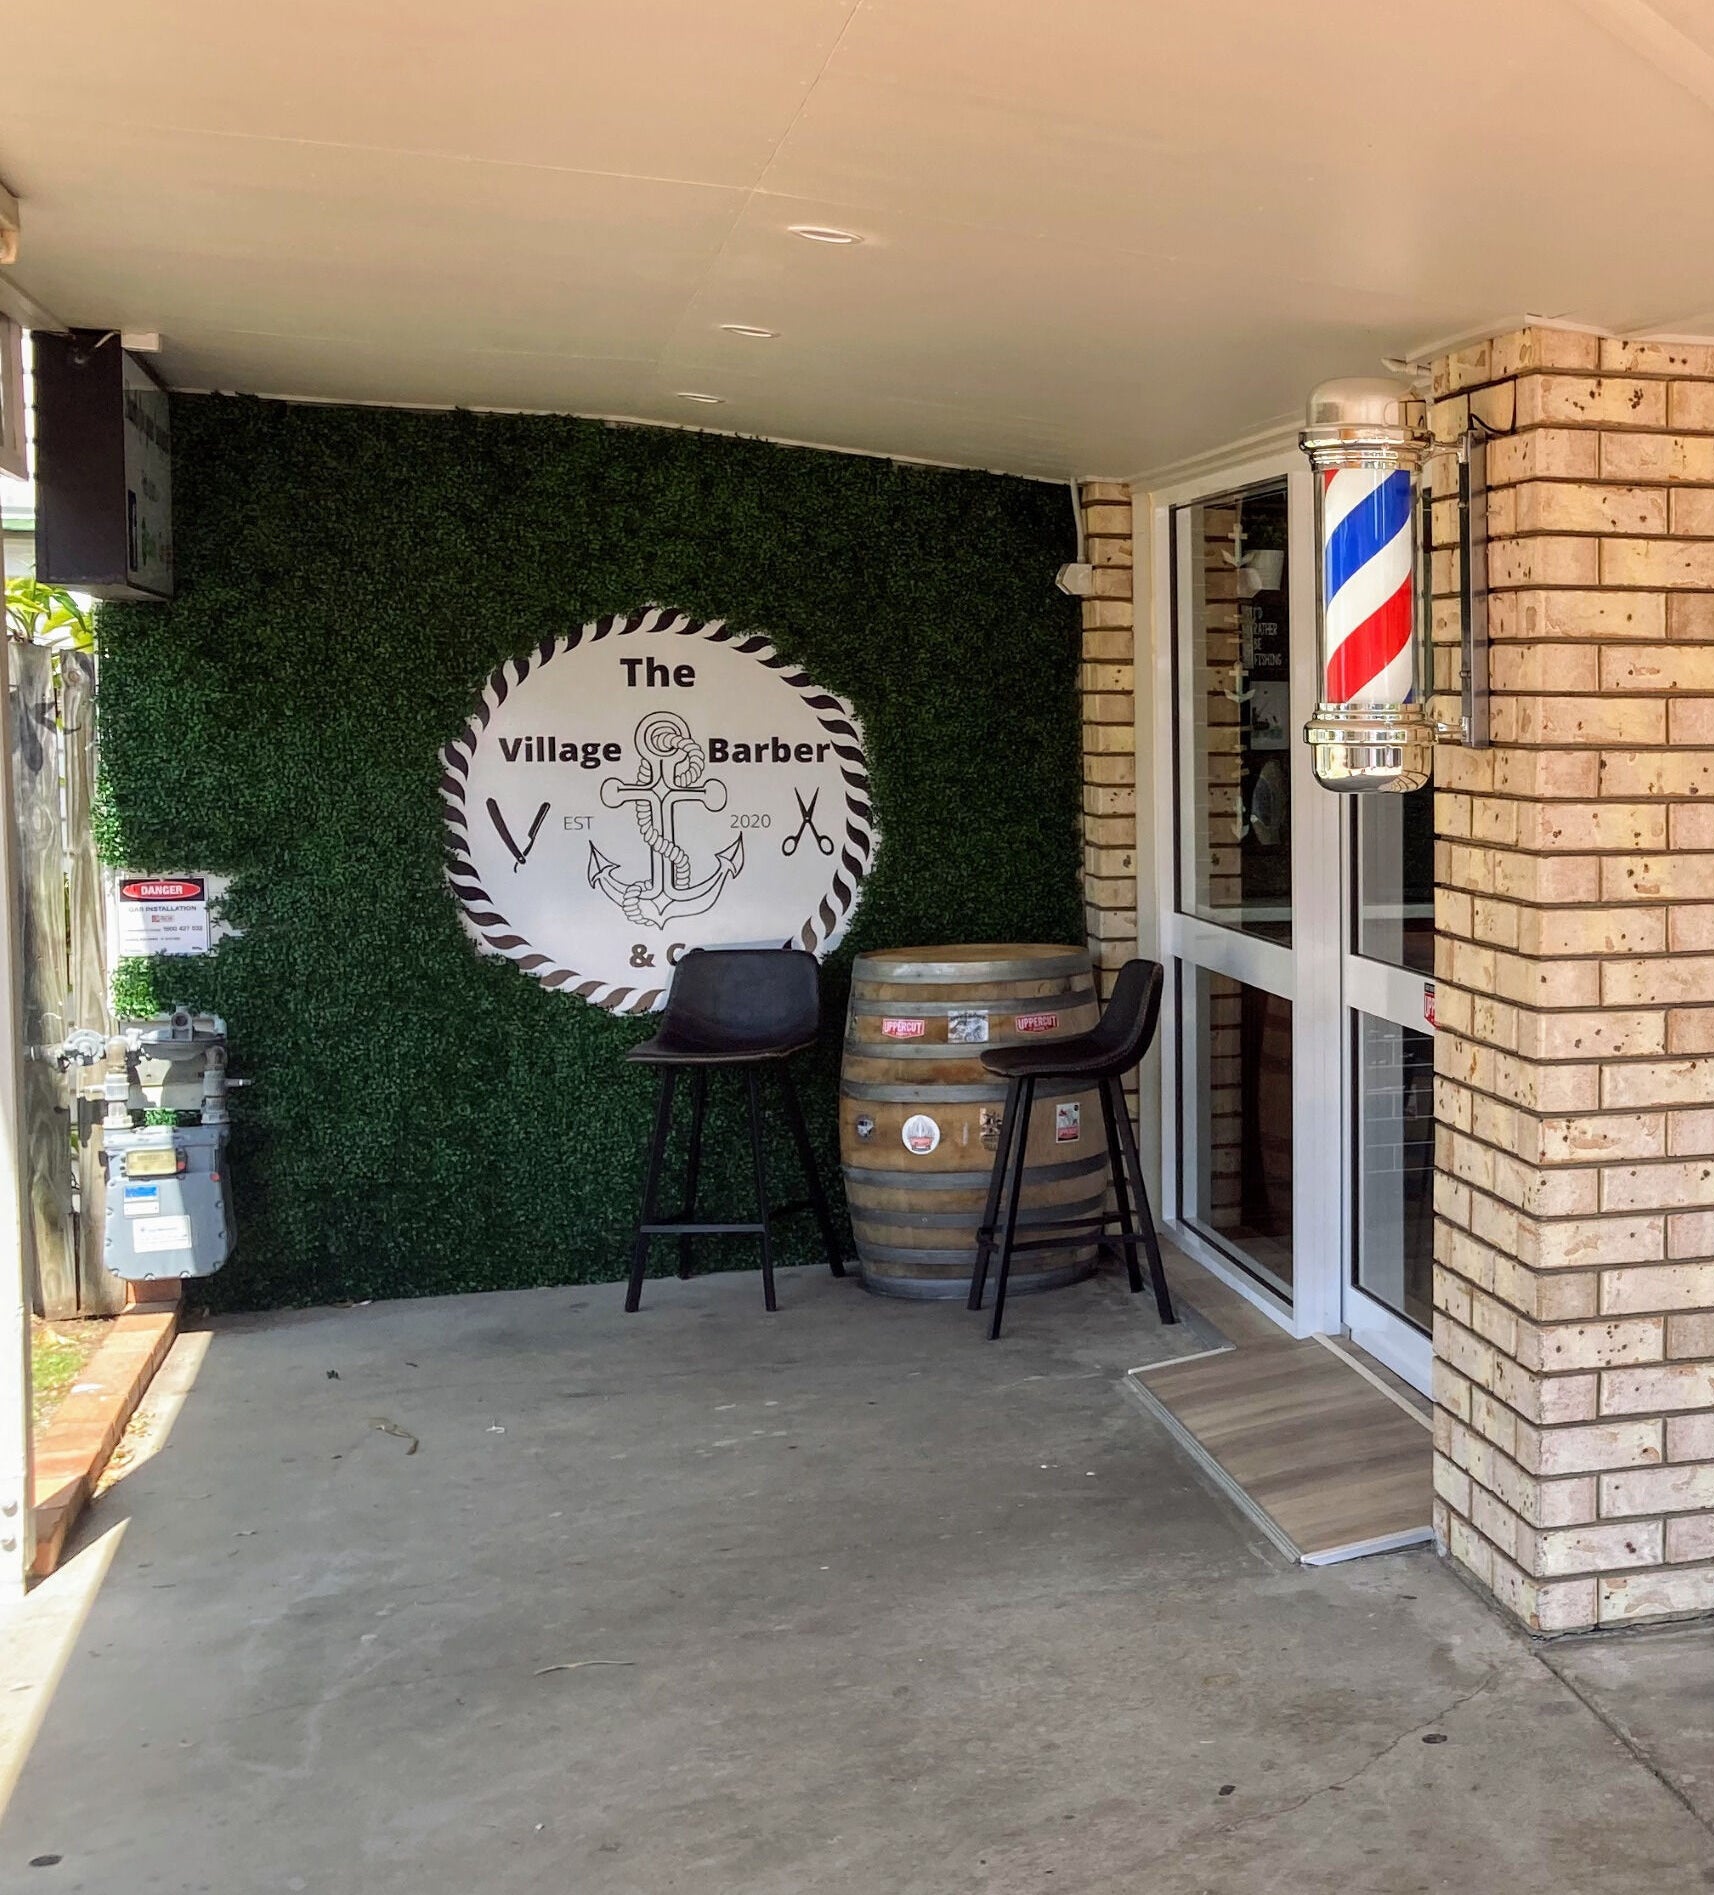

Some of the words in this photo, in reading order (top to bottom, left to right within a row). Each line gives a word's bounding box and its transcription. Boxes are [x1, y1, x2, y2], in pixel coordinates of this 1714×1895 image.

[619, 657, 696, 688] The
[498, 736, 622, 769] Village
[708, 737, 831, 764] Barber
[563, 816, 594, 831] EST
[730, 814, 771, 830] 2020
[140, 885, 183, 896] DANGER
[629, 943, 656, 968] &
[666, 943, 687, 967] C
[884, 1022, 922, 1034] UPPERCUT
[1018, 1016, 1056, 1030] UPPERCUT
